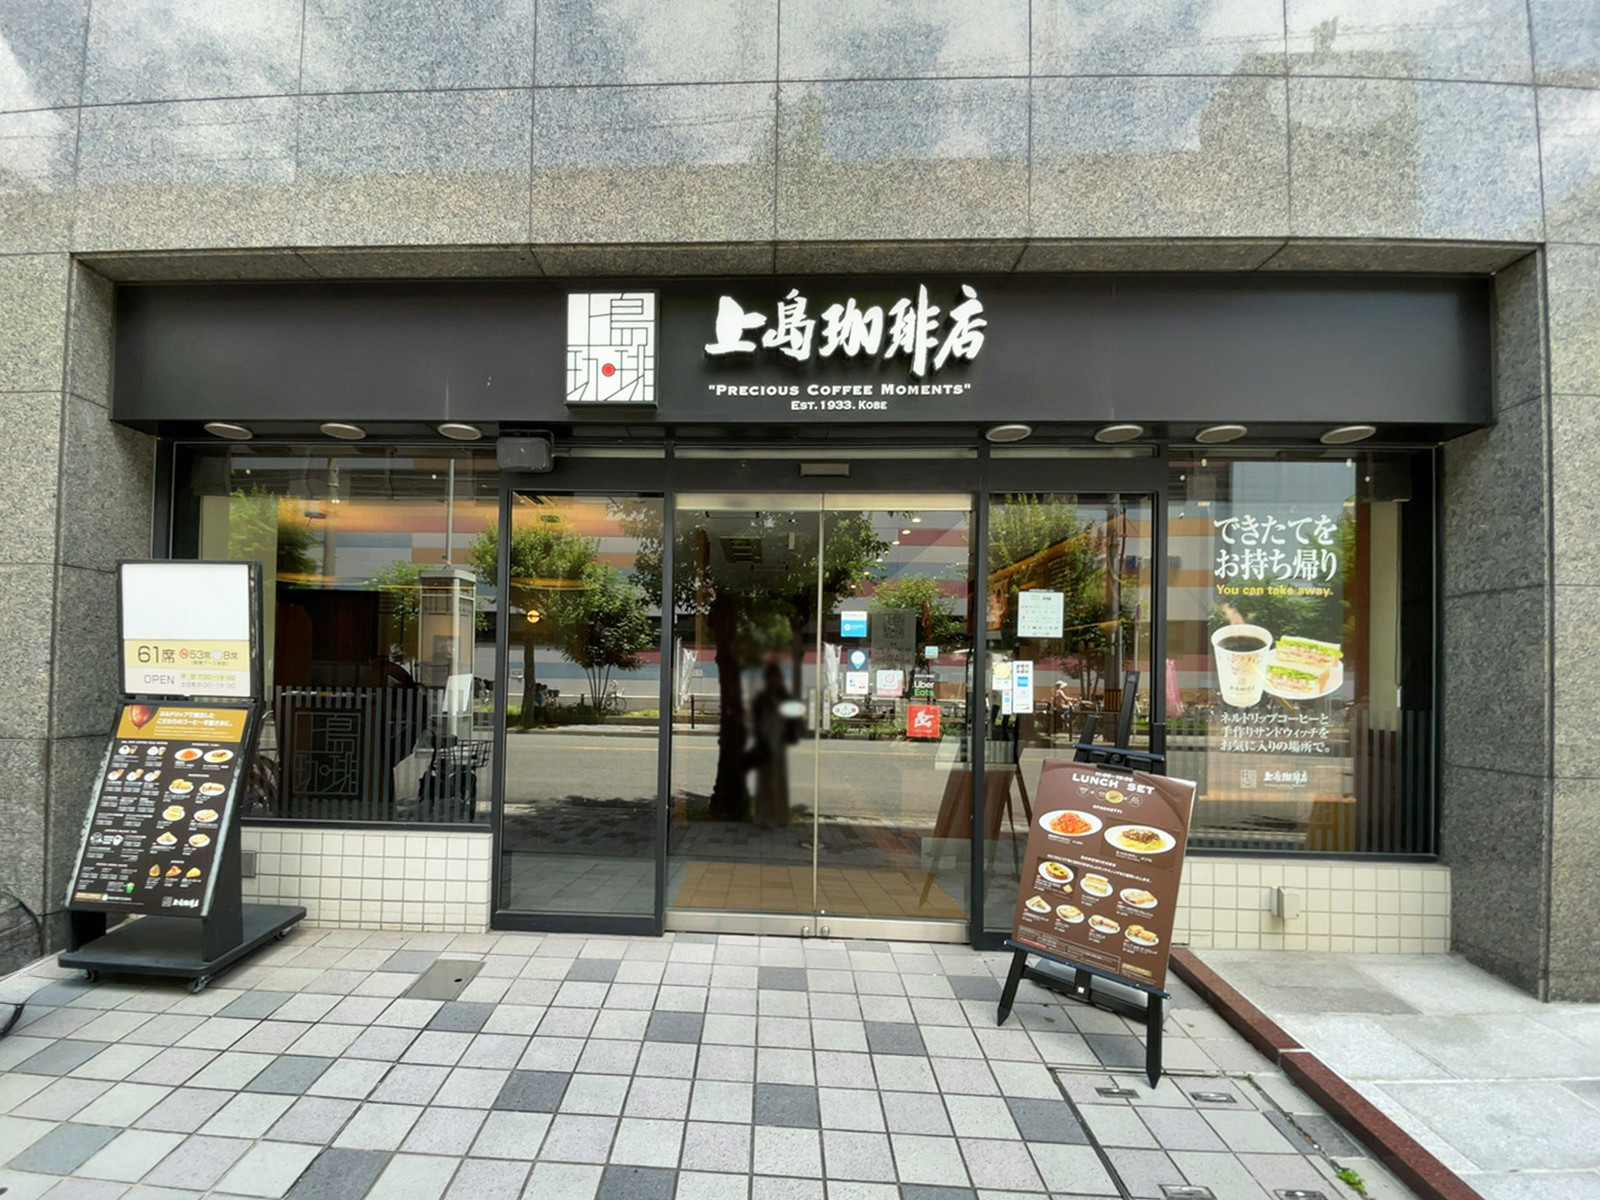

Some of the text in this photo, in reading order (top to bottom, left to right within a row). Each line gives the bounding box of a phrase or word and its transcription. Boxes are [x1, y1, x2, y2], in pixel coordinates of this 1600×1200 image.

[704, 283, 988, 377] 上島珈琲店
[807, 384, 874, 396] COFFEE
[858, 400, 888, 411] KOBE
[1213, 514, 1338, 546] できたてを
[1213, 548, 1338, 581] お持ち帰り
[1216, 584, 1334, 598] You can take away.
[137, 645, 176, 664] 61席
[143, 674, 175, 685] OPEN
[913, 681, 935, 689] Uber
[914, 689, 935, 697] Eats
[1220, 711, 1330, 725] ネルドリップコーヒーと
[1220, 739, 1331, 753] お気に入りの場所で。
[1072, 773, 1120, 789] LUNCH
[1126, 783, 1156, 796] SET
